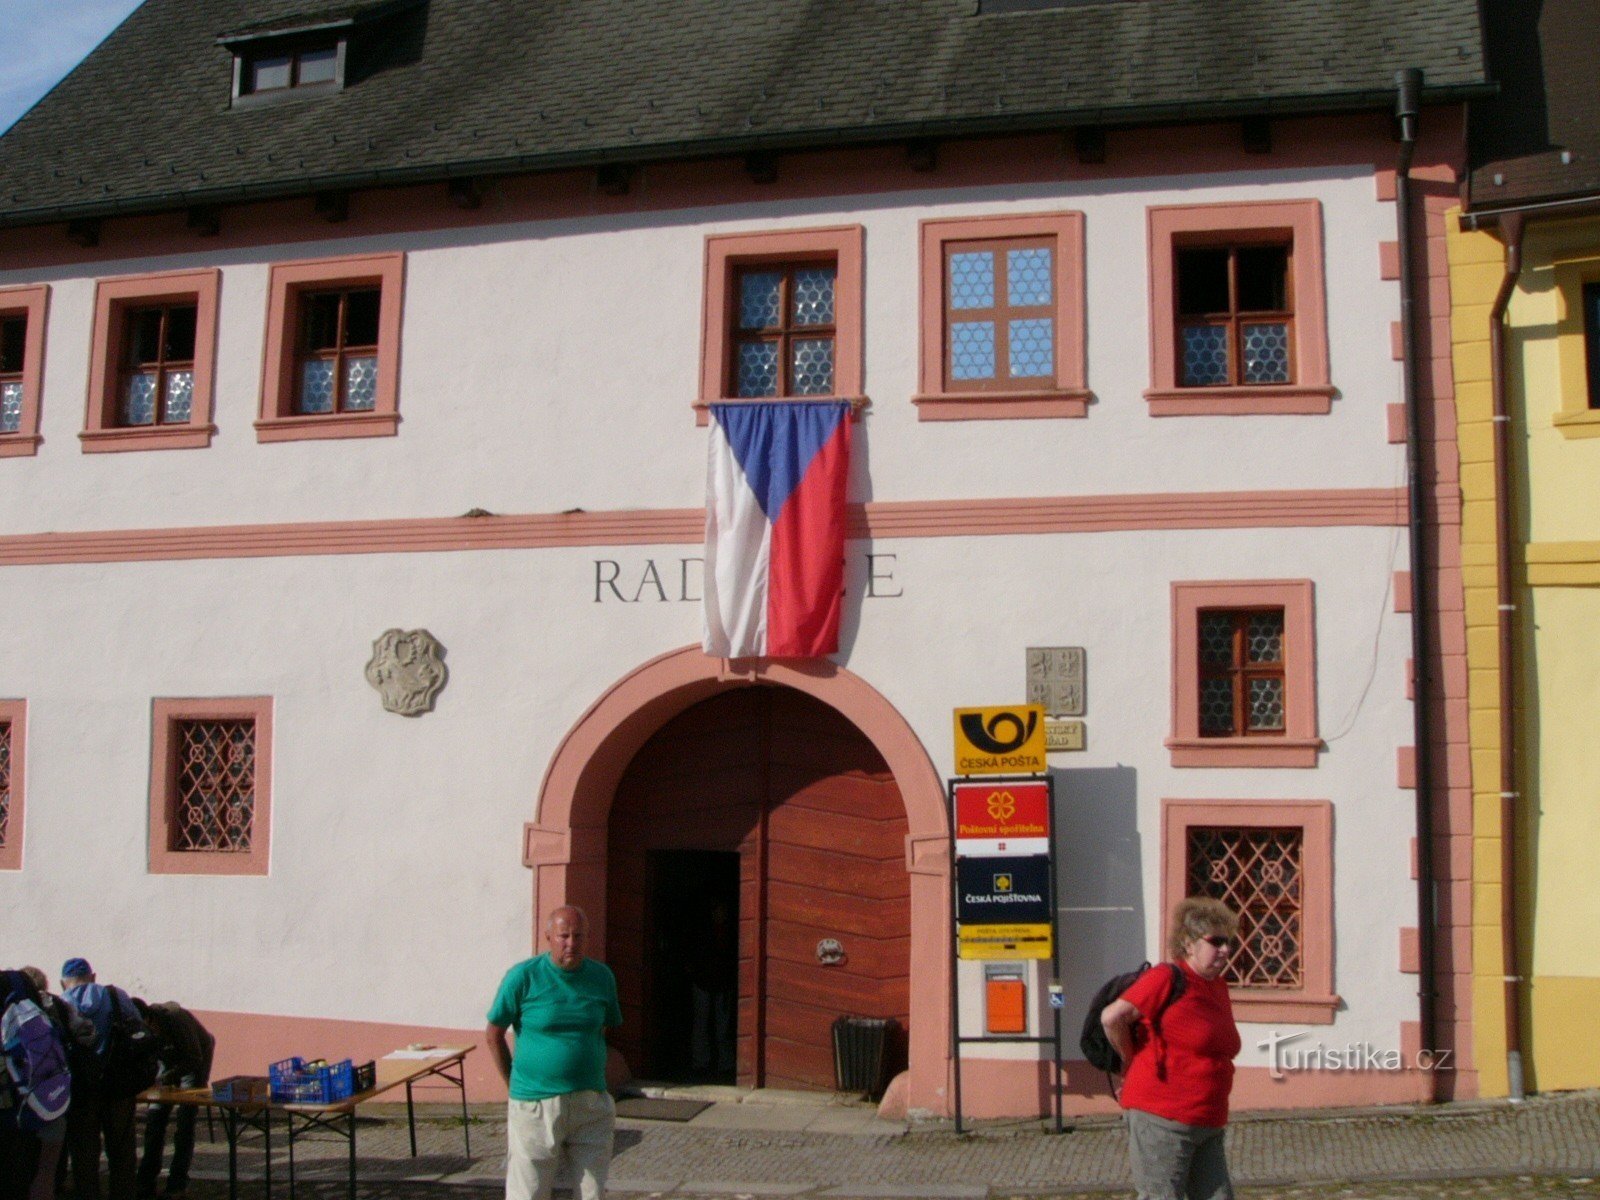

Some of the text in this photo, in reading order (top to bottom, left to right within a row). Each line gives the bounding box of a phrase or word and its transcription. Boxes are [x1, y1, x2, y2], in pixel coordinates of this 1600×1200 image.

[960, 755, 1040, 768] ČESKÁ POŠTA
[965, 894, 1041, 903] ČESKÁ POJIŠŤOVNA
